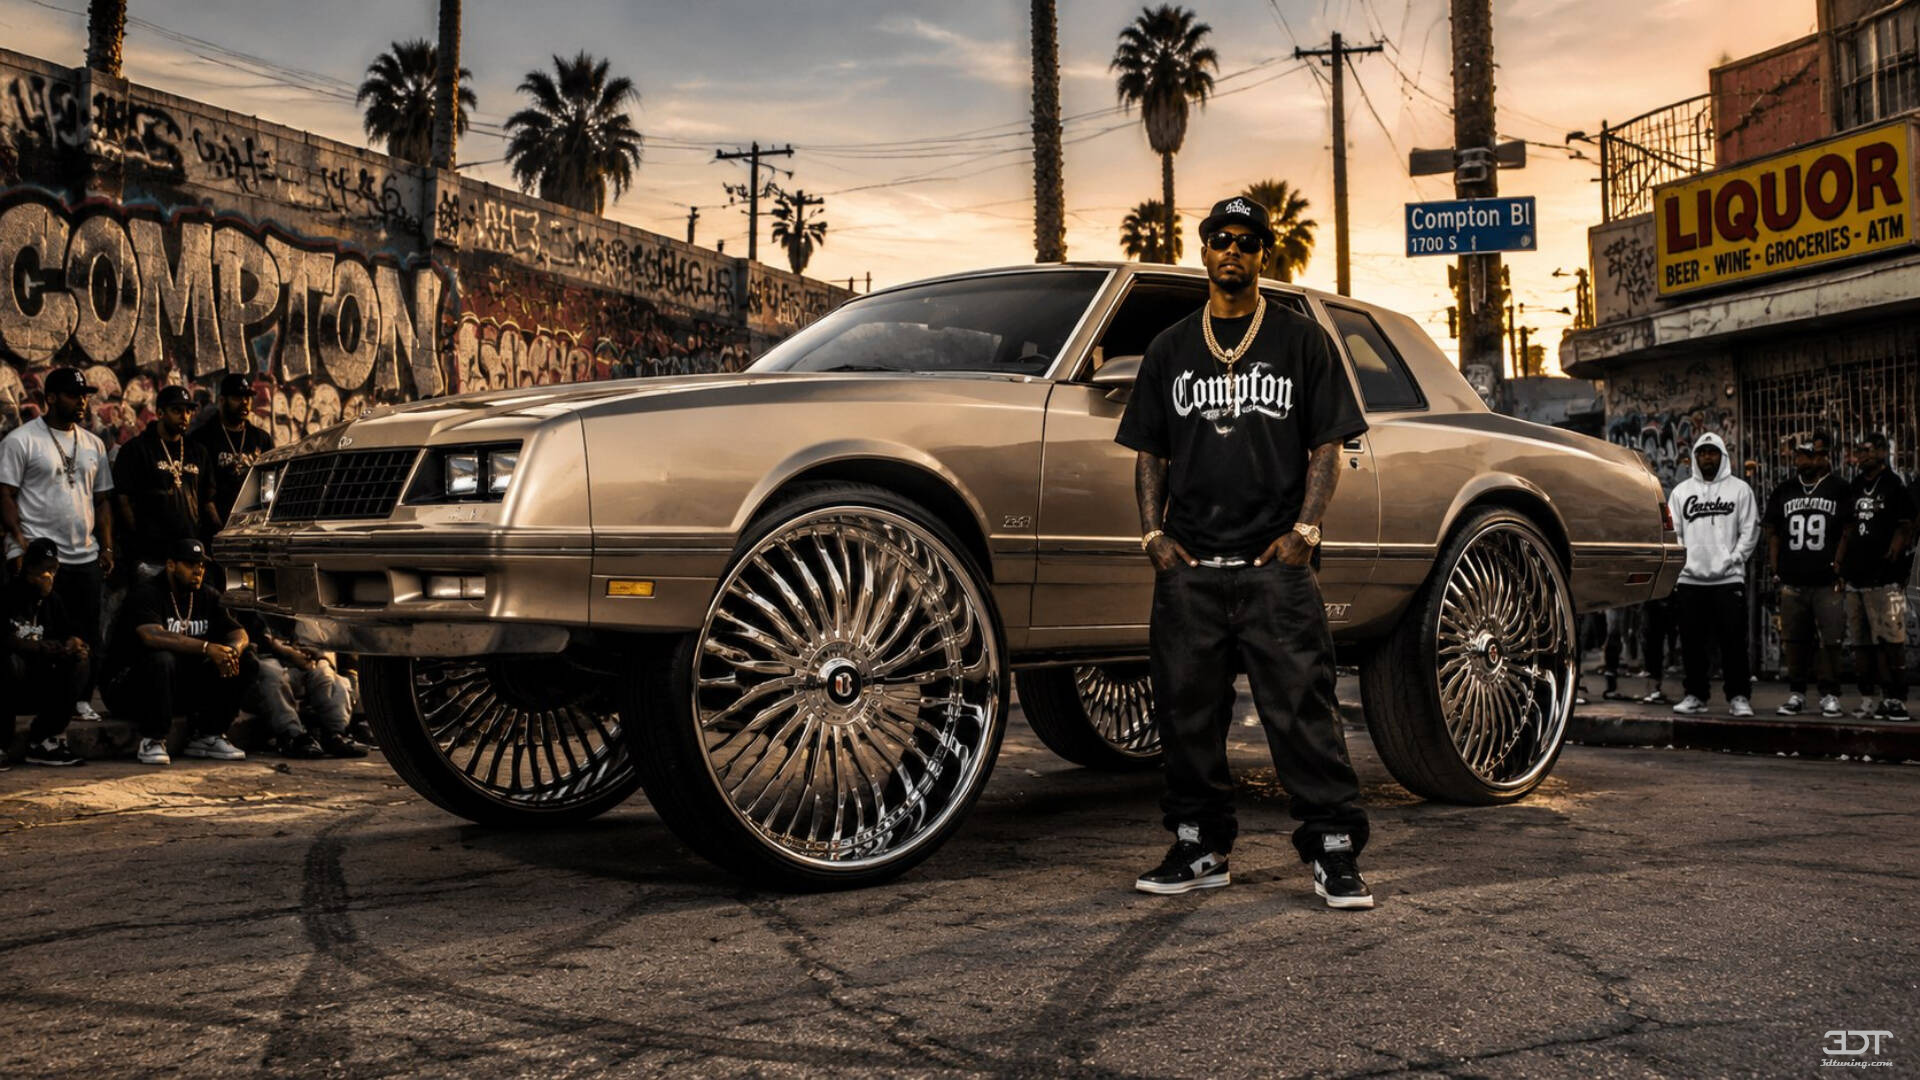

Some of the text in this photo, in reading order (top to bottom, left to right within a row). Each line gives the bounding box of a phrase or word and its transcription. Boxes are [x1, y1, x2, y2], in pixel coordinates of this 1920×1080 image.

[1411, 202, 1530, 233] Compton Bl
[1665, 141, 1903, 254] LIQUOR
[1411, 235, 1457, 252] 1700 S
[1666, 259, 1700, 287] BEER
[1714, 249, 1752, 276] WINE
[1765, 225, 1850, 266] GROCERIES
[1867, 214, 1904, 244] ATM
[0, 202, 444, 397] COMPTON
[1172, 362, 1294, 419] Compton
[1789, 514, 1826, 551] 99
